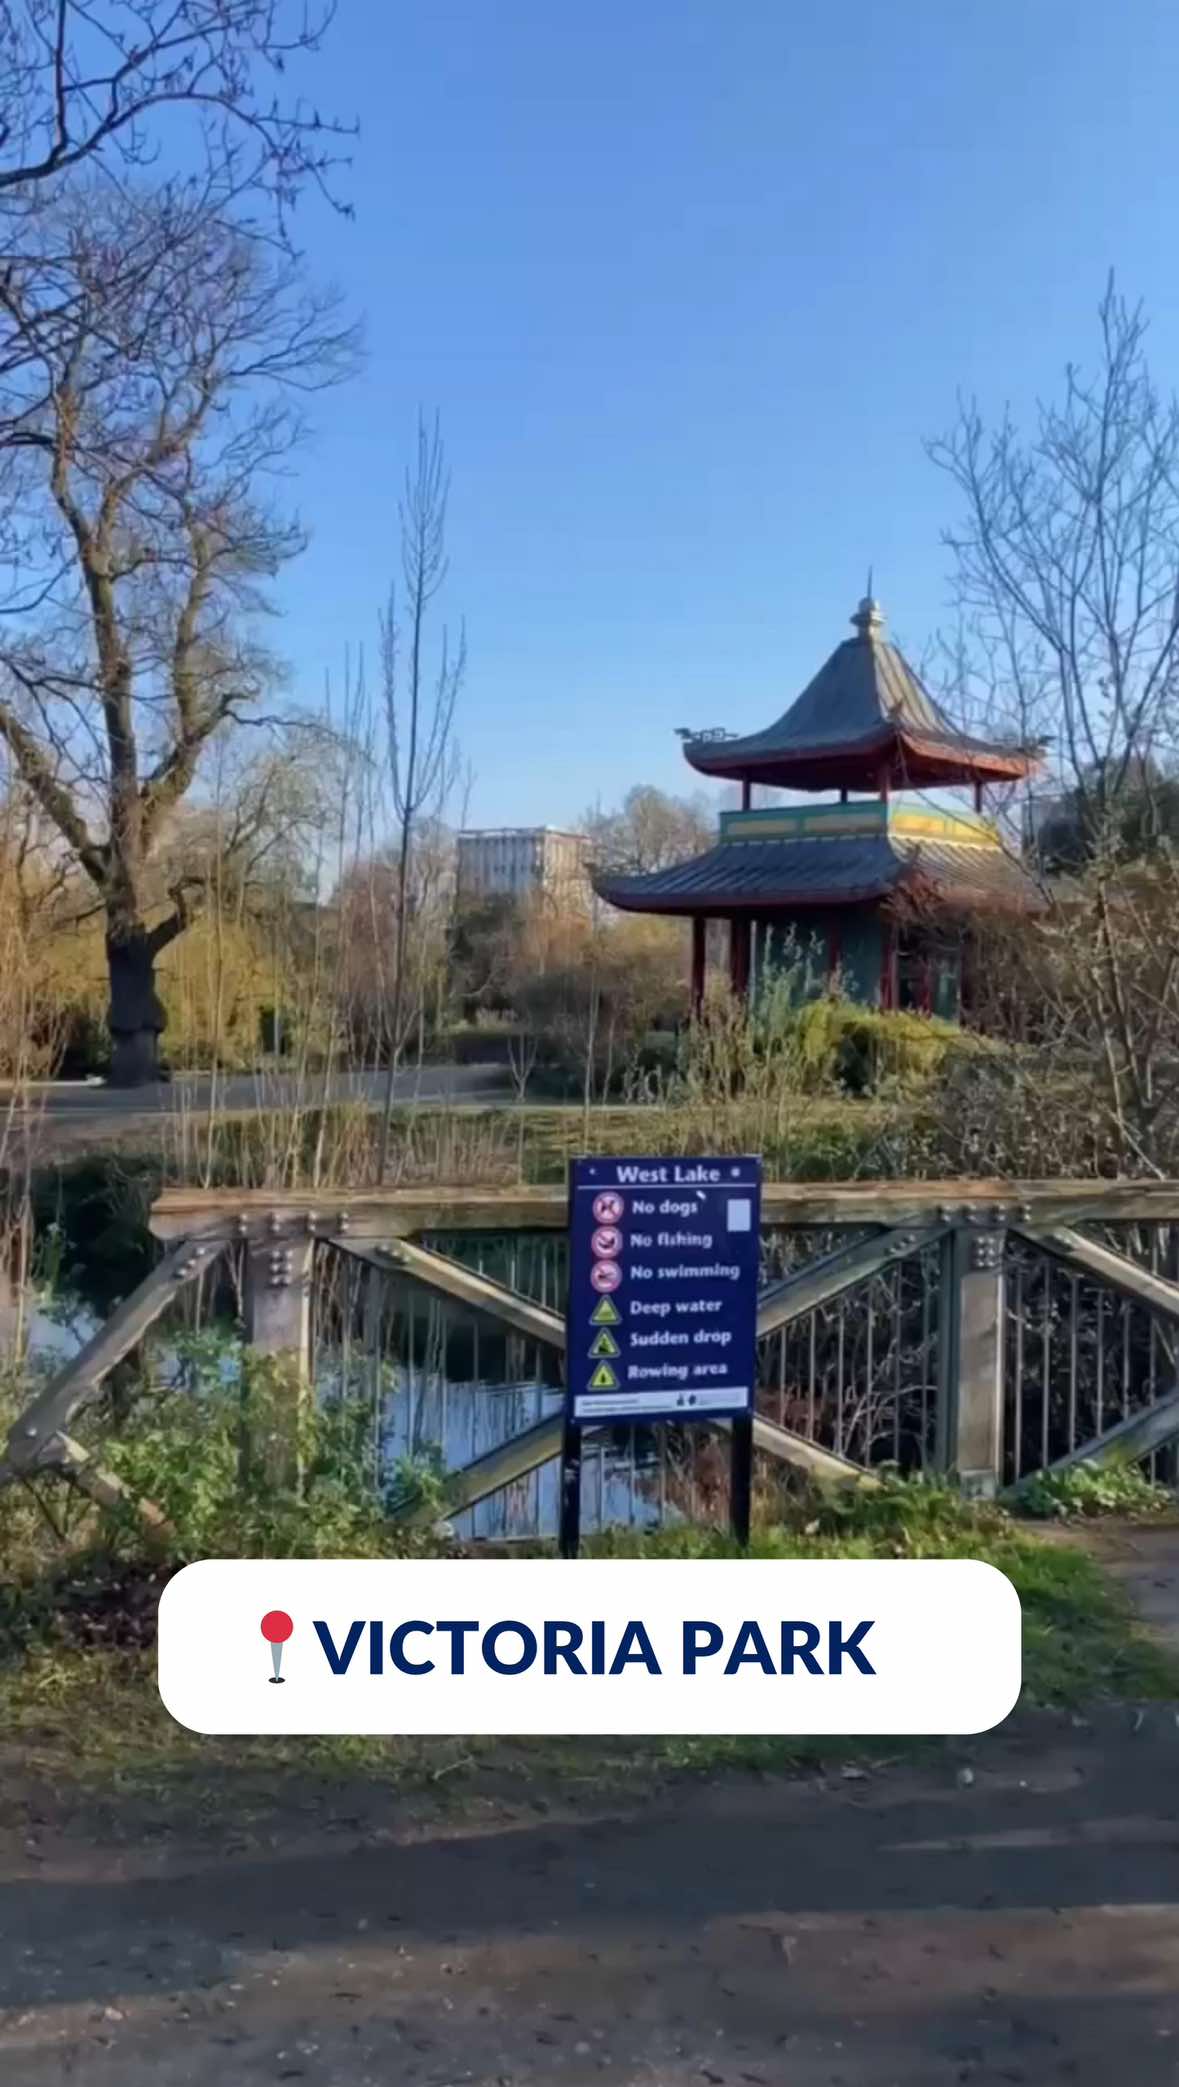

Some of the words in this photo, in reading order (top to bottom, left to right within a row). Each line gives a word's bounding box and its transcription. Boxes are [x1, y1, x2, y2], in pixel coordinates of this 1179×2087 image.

[616, 1165, 668, 1183] West
[674, 1164, 721, 1182] Lake
[632, 1200, 655, 1214] No
[659, 1199, 698, 1217] dogs
[630, 1234, 653, 1247] No
[657, 1232, 713, 1248] fishing
[630, 1265, 652, 1279] No
[657, 1263, 741, 1280] swimming
[630, 1301, 671, 1317] Deep
[675, 1300, 723, 1313] water
[630, 1331, 689, 1346] Sudden
[693, 1329, 732, 1347] drop
[627, 1363, 689, 1380] Rowing
[693, 1363, 728, 1376] area
